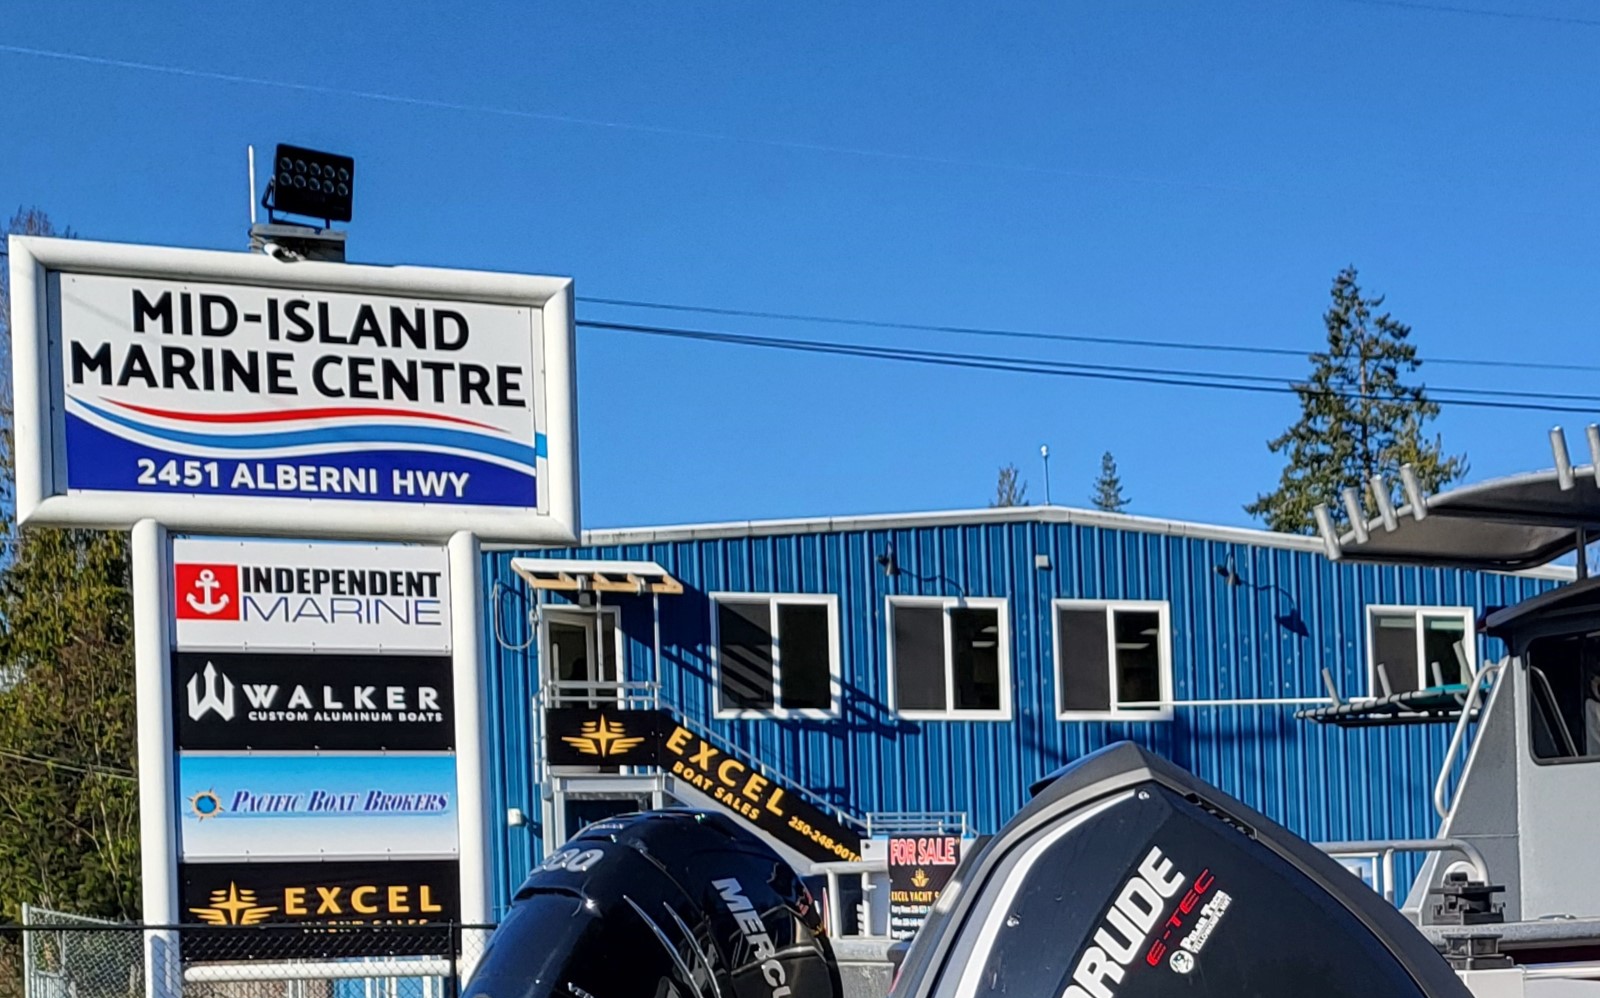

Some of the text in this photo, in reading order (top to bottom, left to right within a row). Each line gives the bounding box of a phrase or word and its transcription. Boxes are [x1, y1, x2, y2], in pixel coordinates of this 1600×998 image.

[133, 288, 470, 351] MID-ISLAND
[71, 340, 527, 408] MARINE CENTRE
[136, 458, 471, 498] 2451 ALBERNI HWY
[241, 566, 442, 598] INDEPENDENT
[242, 596, 442, 626] MARINE
[242, 684, 441, 711] WALKER
[247, 711, 444, 723] CUSTOM ALUMINUM BOATS
[665, 725, 785, 817] EXCEL
[306, 789, 359, 812] BOAT
[363, 790, 449, 812] BROKERS
[672, 760, 761, 820] BOAT SALES
[890, 836, 957, 866] FOR SALE
[284, 884, 442, 915] EXCEL
[1146, 868, 1215, 967] E-TEC
